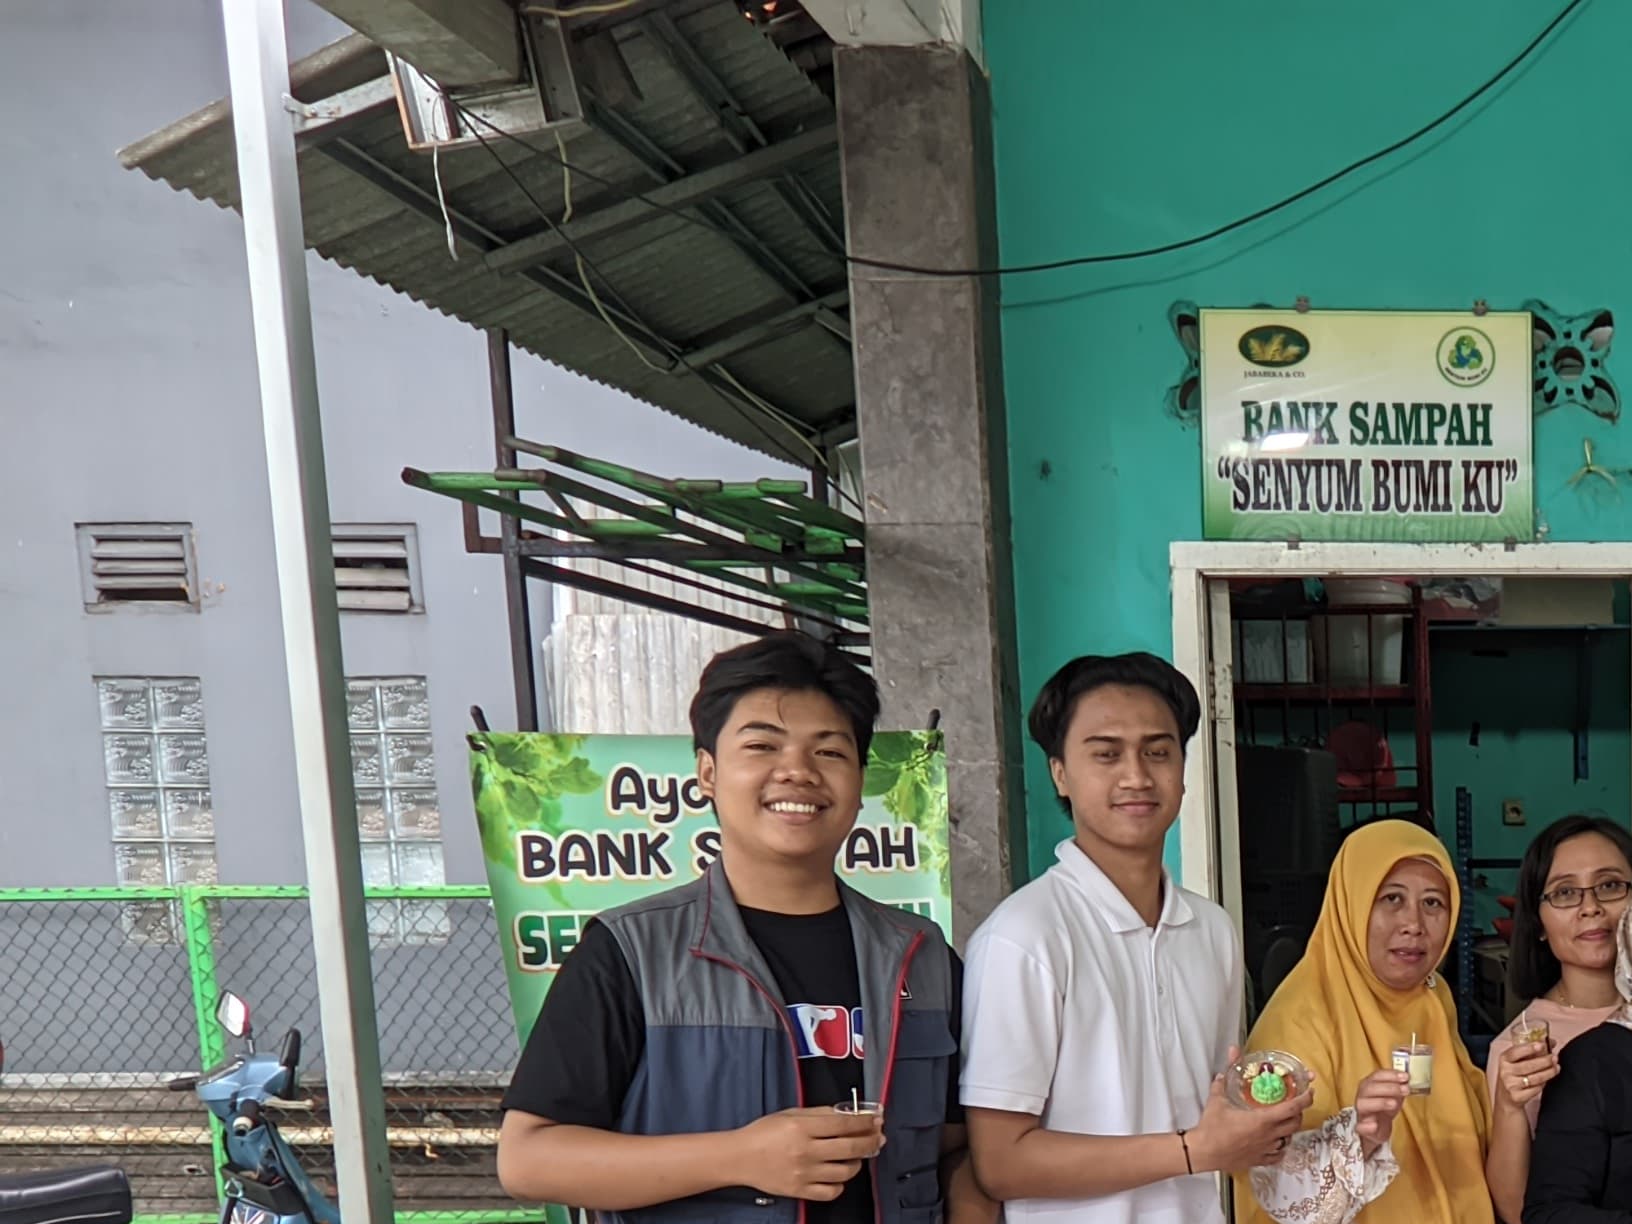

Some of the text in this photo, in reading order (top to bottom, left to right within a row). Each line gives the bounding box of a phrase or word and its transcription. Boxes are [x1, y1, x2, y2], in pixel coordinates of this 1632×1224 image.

[1241, 400, 1493, 446] BANK SAMPAH
[1372, 459, 1453, 513] BUMI
[521, 832, 672, 878] BANK
